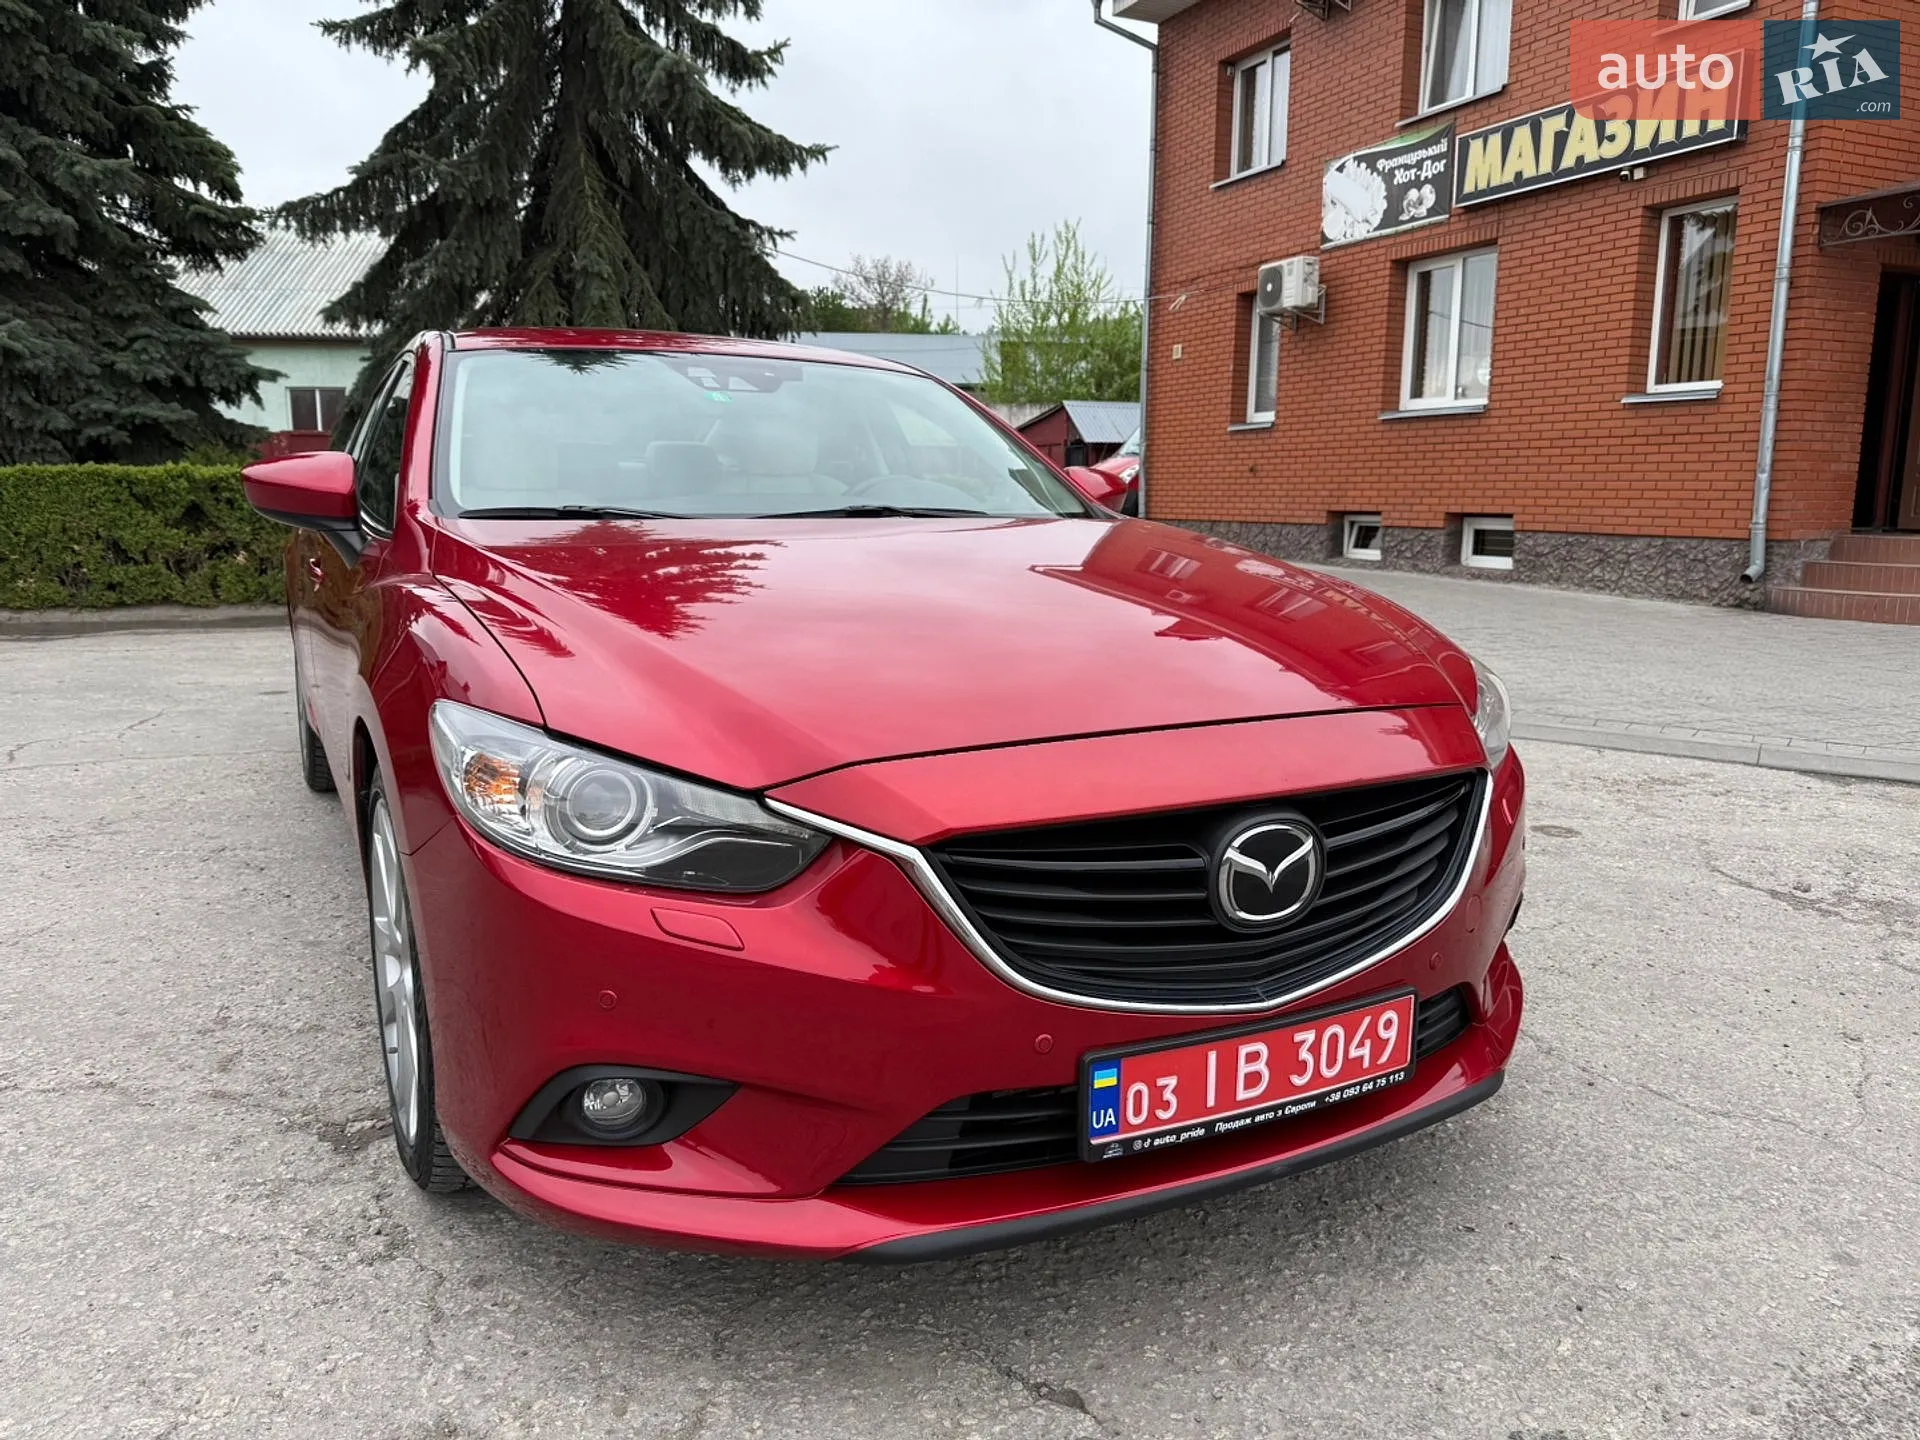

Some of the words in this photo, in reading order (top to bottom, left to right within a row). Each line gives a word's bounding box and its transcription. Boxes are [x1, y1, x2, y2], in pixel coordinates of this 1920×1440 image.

[1463, 65, 1728, 196] МАГАЗИН
[1376, 137, 1448, 173] Французький
[1393, 159, 1447, 185] Хот-Дог
[1125, 1075, 1179, 1127] 03
[1289, 1009, 1399, 1087] 3049
[1092, 1108, 1117, 1129] UA
[1153, 1127, 1206, 1146] auto_pride
[1214, 1117, 1252, 1133] Продаж
[1254, 1111, 1275, 1123] авто
[1284, 1101, 1317, 1115] Європи
[1325, 1091, 1342, 1103] +38
